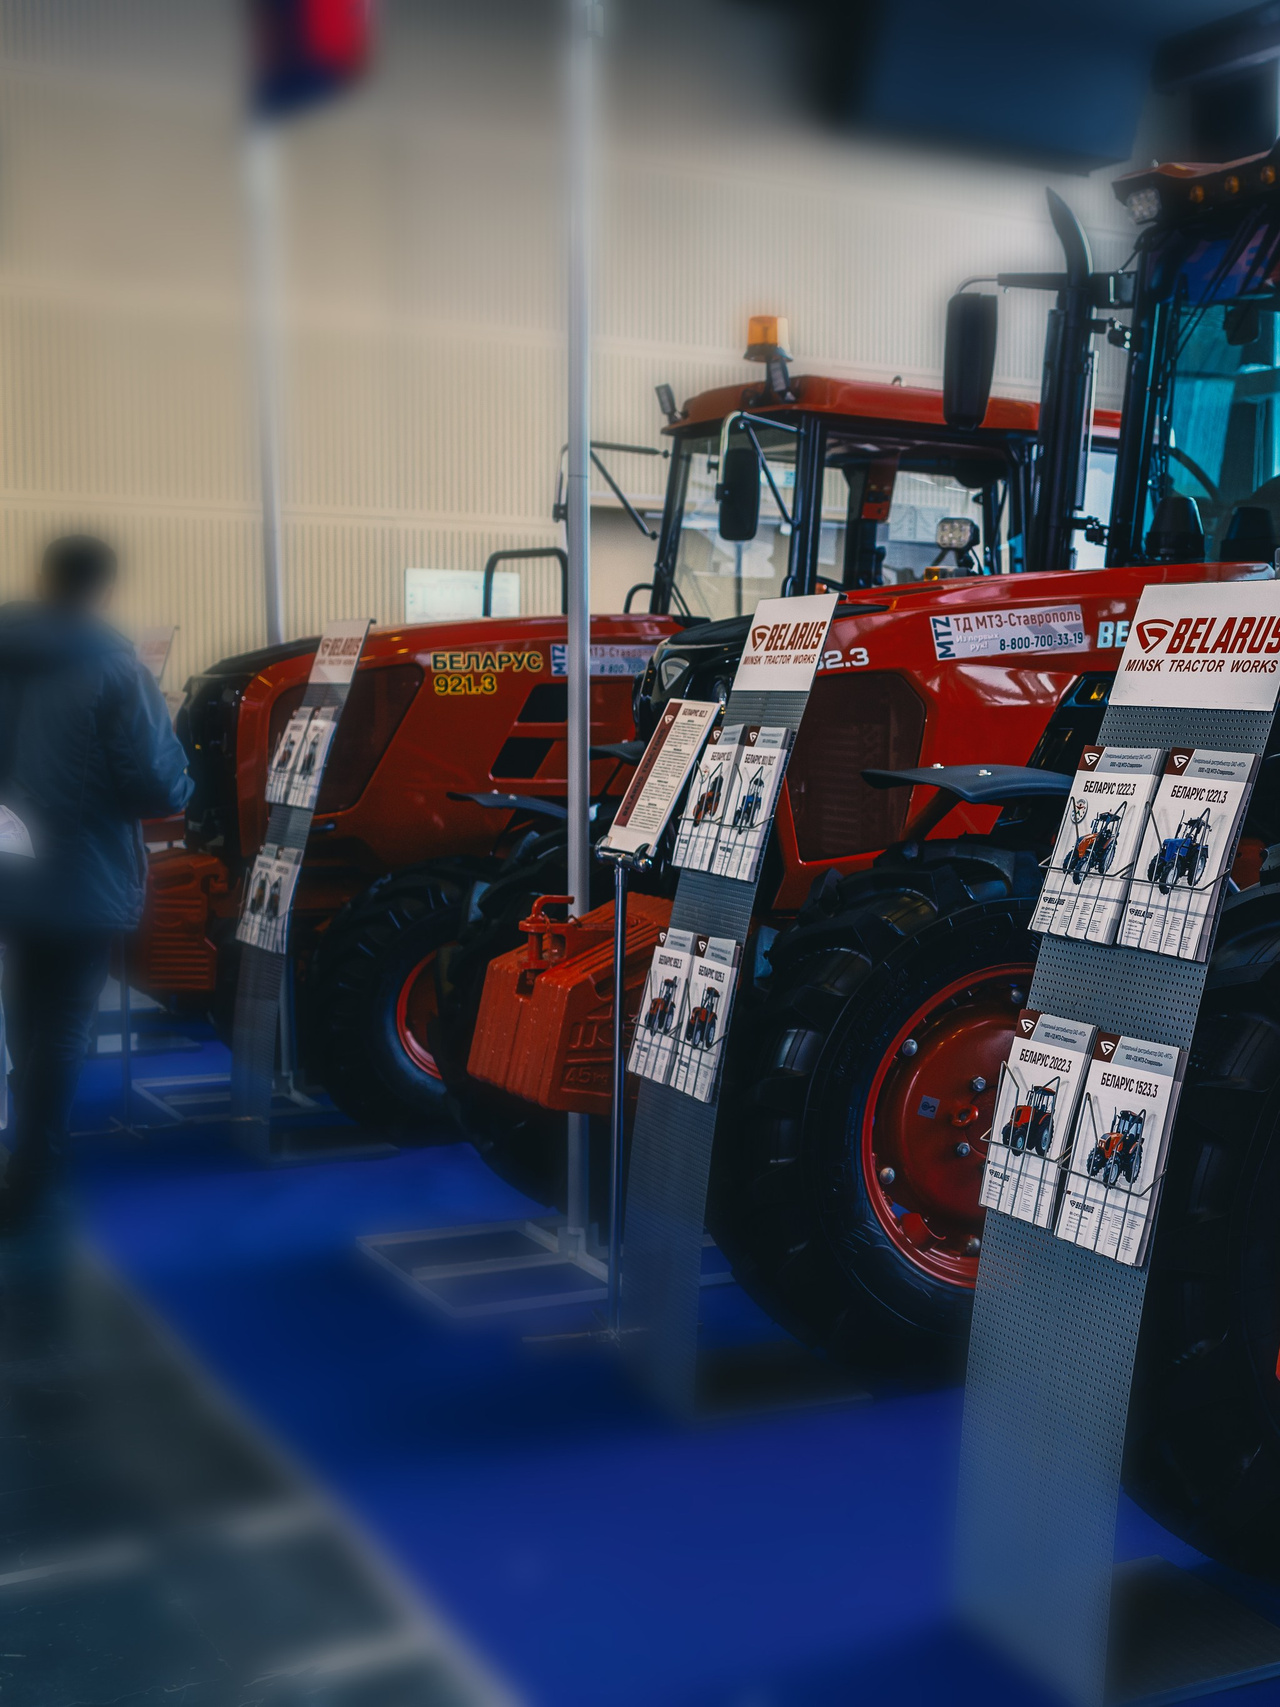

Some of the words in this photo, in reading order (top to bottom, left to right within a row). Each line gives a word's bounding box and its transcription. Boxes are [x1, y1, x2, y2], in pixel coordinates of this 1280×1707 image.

[953, 617, 974, 633] ТД
[975, 609, 1082, 628] МТЗ-Ставрополь
[763, 621, 828, 652] BELARUS
[937, 616, 954, 659] MTZ
[999, 632, 1084, 651] 8-800-700-33-19
[431, 651, 544, 673] БЕЛАРУС
[551, 645, 566, 675] MTZ
[743, 656, 763, 666] MINSK
[763, 655, 792, 665] TRACTOR
[792, 654, 817, 664] WORKS
[1124, 658, 1162, 672] MINSK
[1168, 658, 1226, 673] TRACTOR
[1230, 659, 1279, 673] WORKS
[434, 674, 497, 696] 921.3
[1083, 780, 1116, 795] БЕЛАРУС
[1116, 783, 1136, 797] 1222.3
[1171, 785, 1206, 801] БЕЛАРУС
[1205, 789, 1228, 804] 1221.3
[1019, 1048, 1050, 1068] БЕЛАРУС
[1049, 1055, 1072, 1074] 2022.3
[1101, 1072, 1136, 1092] БЕЛАРУС
[1135, 1080, 1159, 1099] 1523.3
